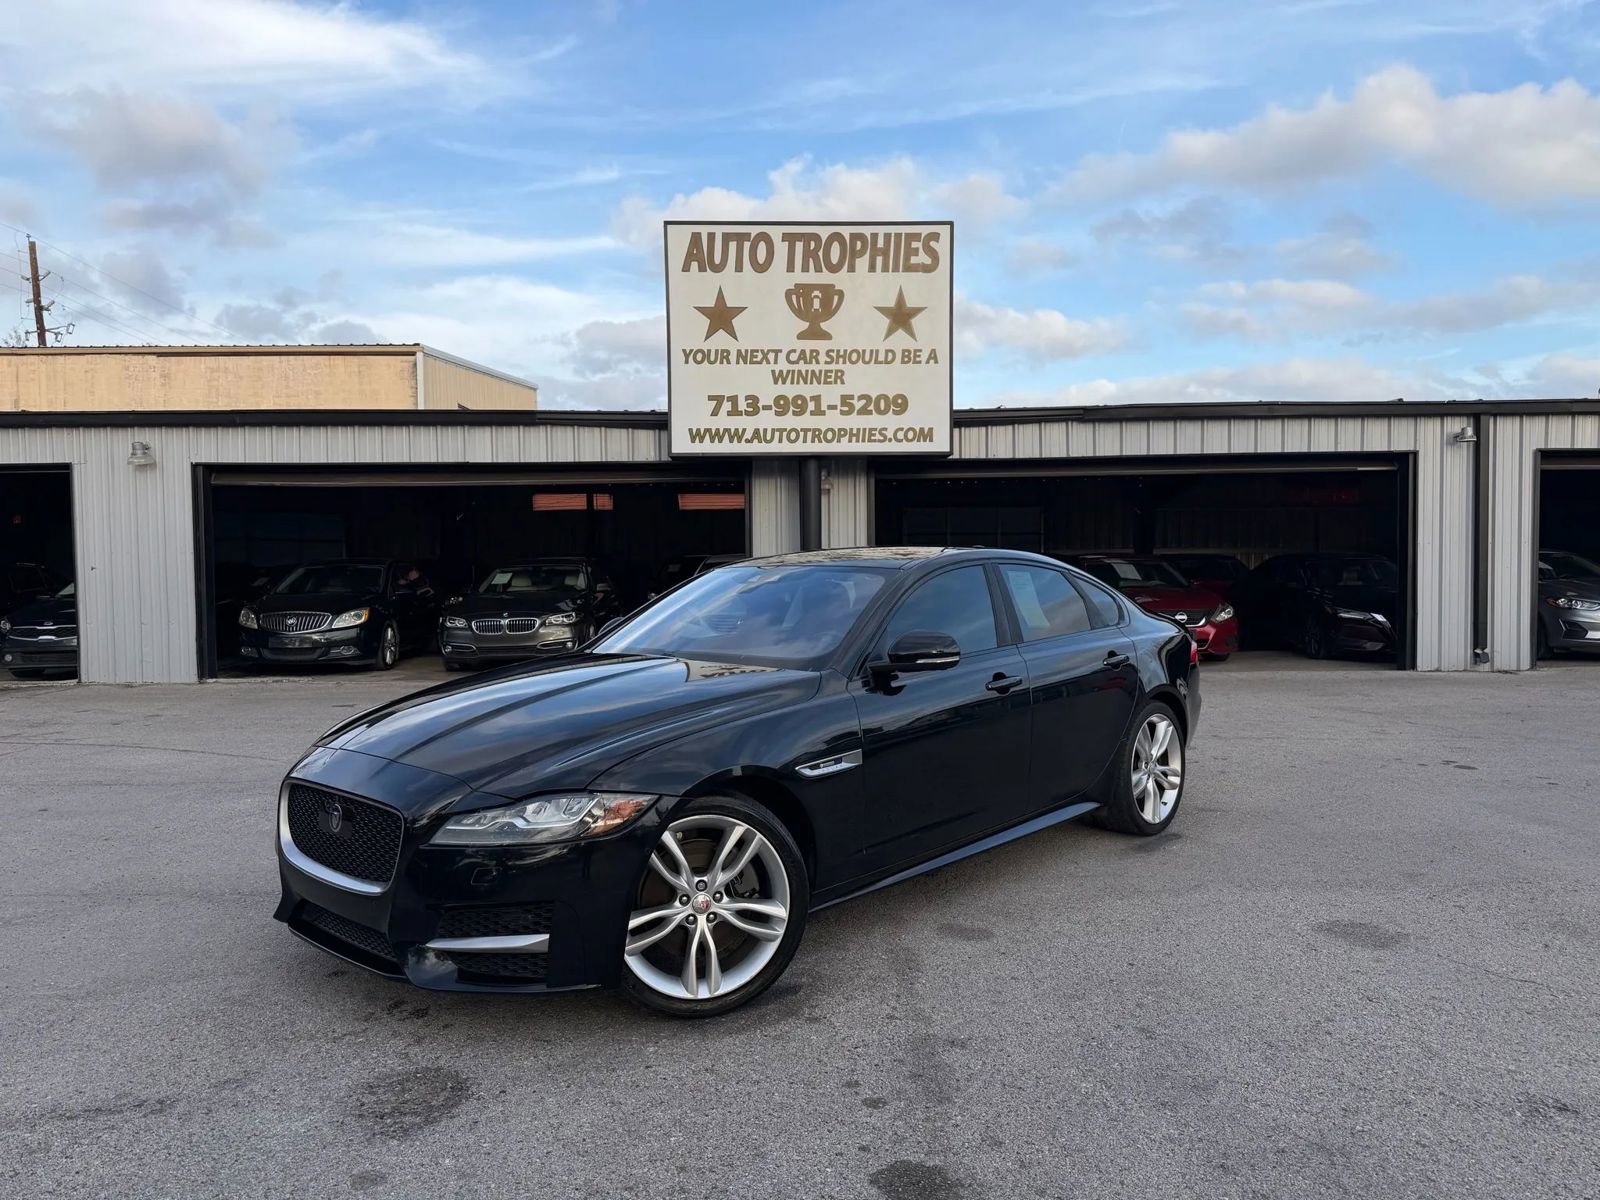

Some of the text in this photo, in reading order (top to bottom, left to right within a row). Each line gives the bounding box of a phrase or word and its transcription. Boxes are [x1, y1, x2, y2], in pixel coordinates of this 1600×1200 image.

[681, 231, 941, 273] AUTO TROPHIES
[681, 348, 939, 365] YOUR NEXT CAR SHOULD BE A
[771, 369, 845, 385] WINNER
[707, 393, 909, 417] 713-991-5209
[688, 427, 934, 444] WWW.AUTOTROPHIES.COM
